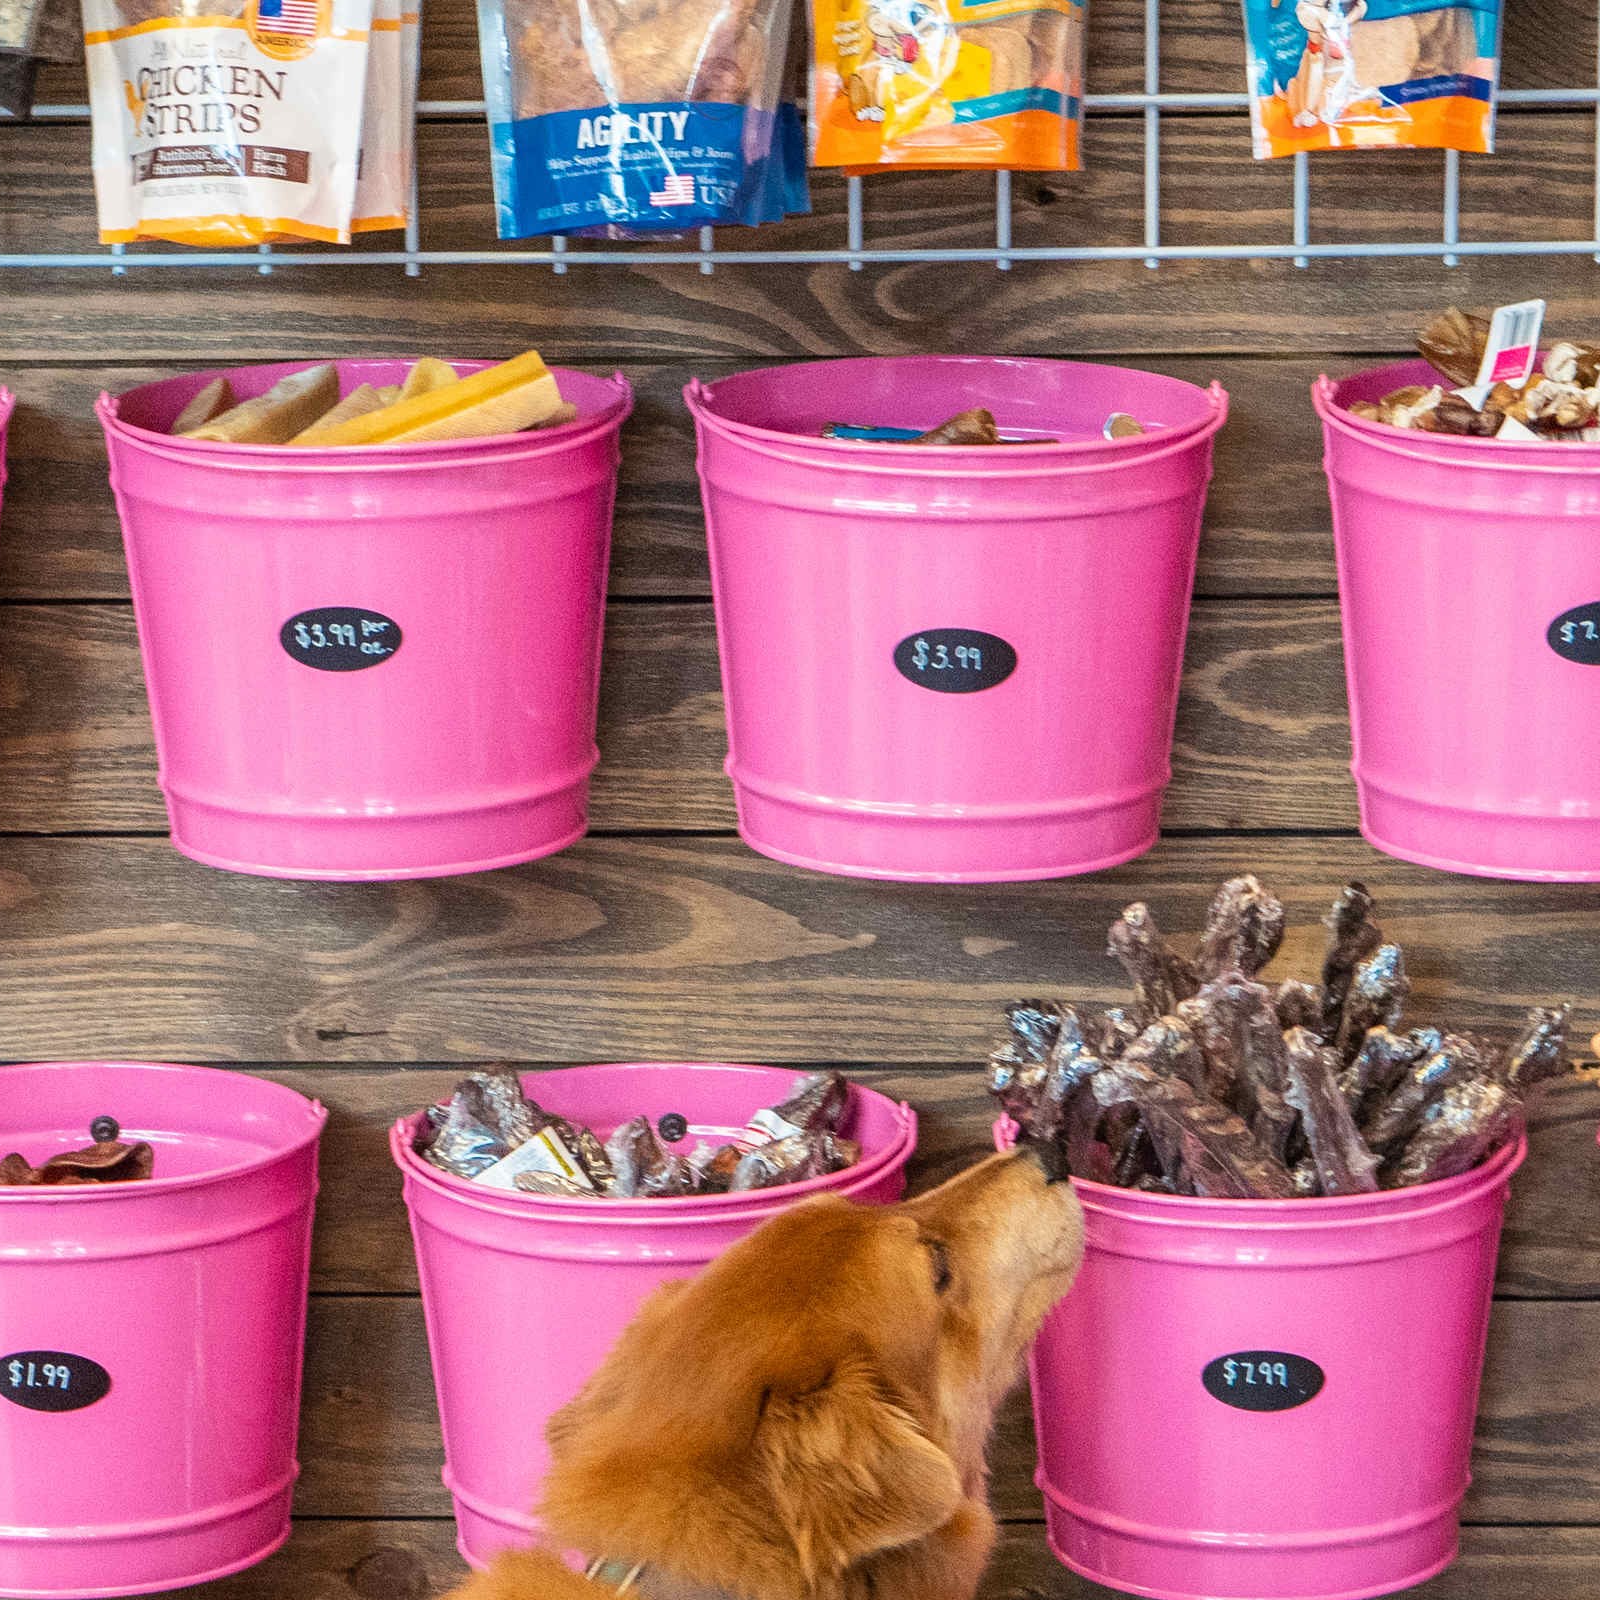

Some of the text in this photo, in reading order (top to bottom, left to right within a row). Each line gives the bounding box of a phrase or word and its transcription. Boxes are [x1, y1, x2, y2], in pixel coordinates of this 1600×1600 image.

[138, 65, 287, 101] CHICKEN
[145, 102, 262, 138] STRIPS
[577, 111, 689, 149] AGLITY
[294, 620, 358, 649] $3.99
[912, 637, 982, 671] $3.99
[8, 1359, 72, 1391] $1.99
[1223, 1358, 1288, 1387] $7.99
